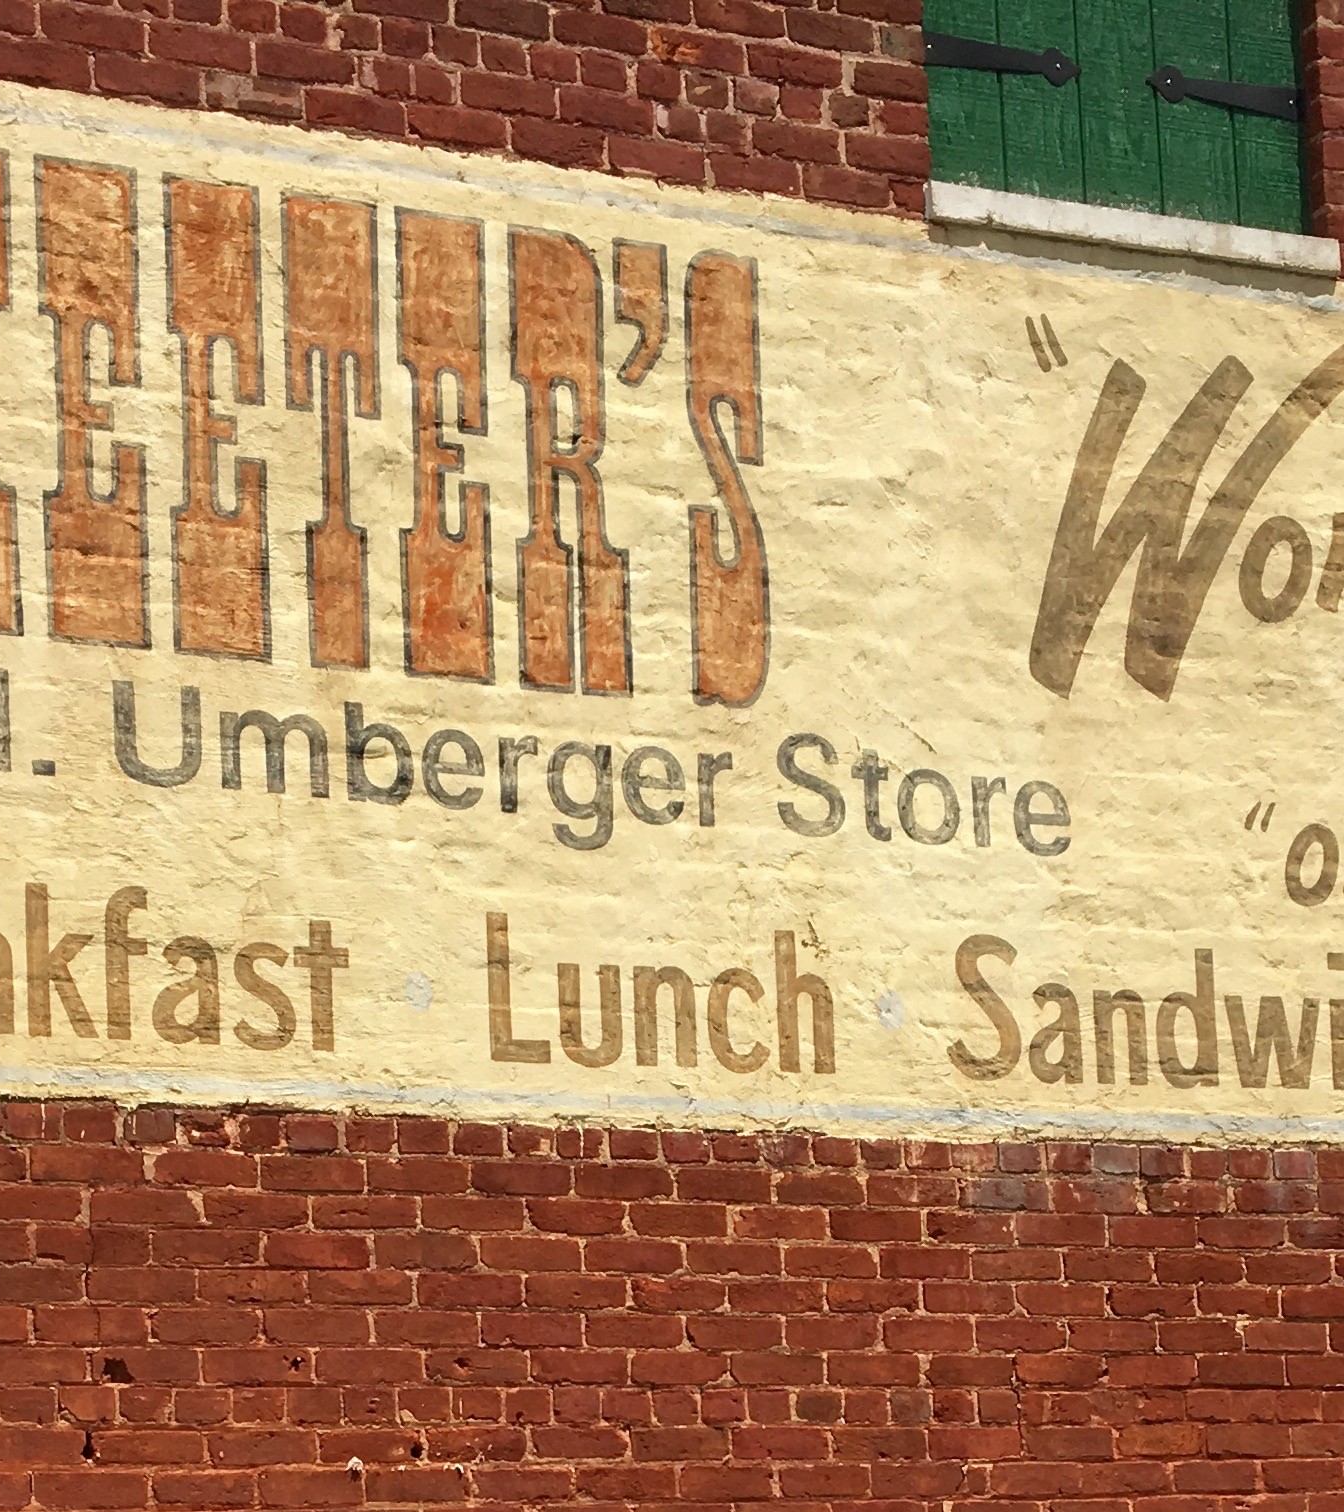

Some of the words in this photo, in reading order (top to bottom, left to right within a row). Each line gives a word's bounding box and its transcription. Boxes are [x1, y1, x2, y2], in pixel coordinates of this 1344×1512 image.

[112, 680, 732, 850] Umberger
[777, 732, 1072, 856] Store
[486, 912, 835, 1074] Lunch
